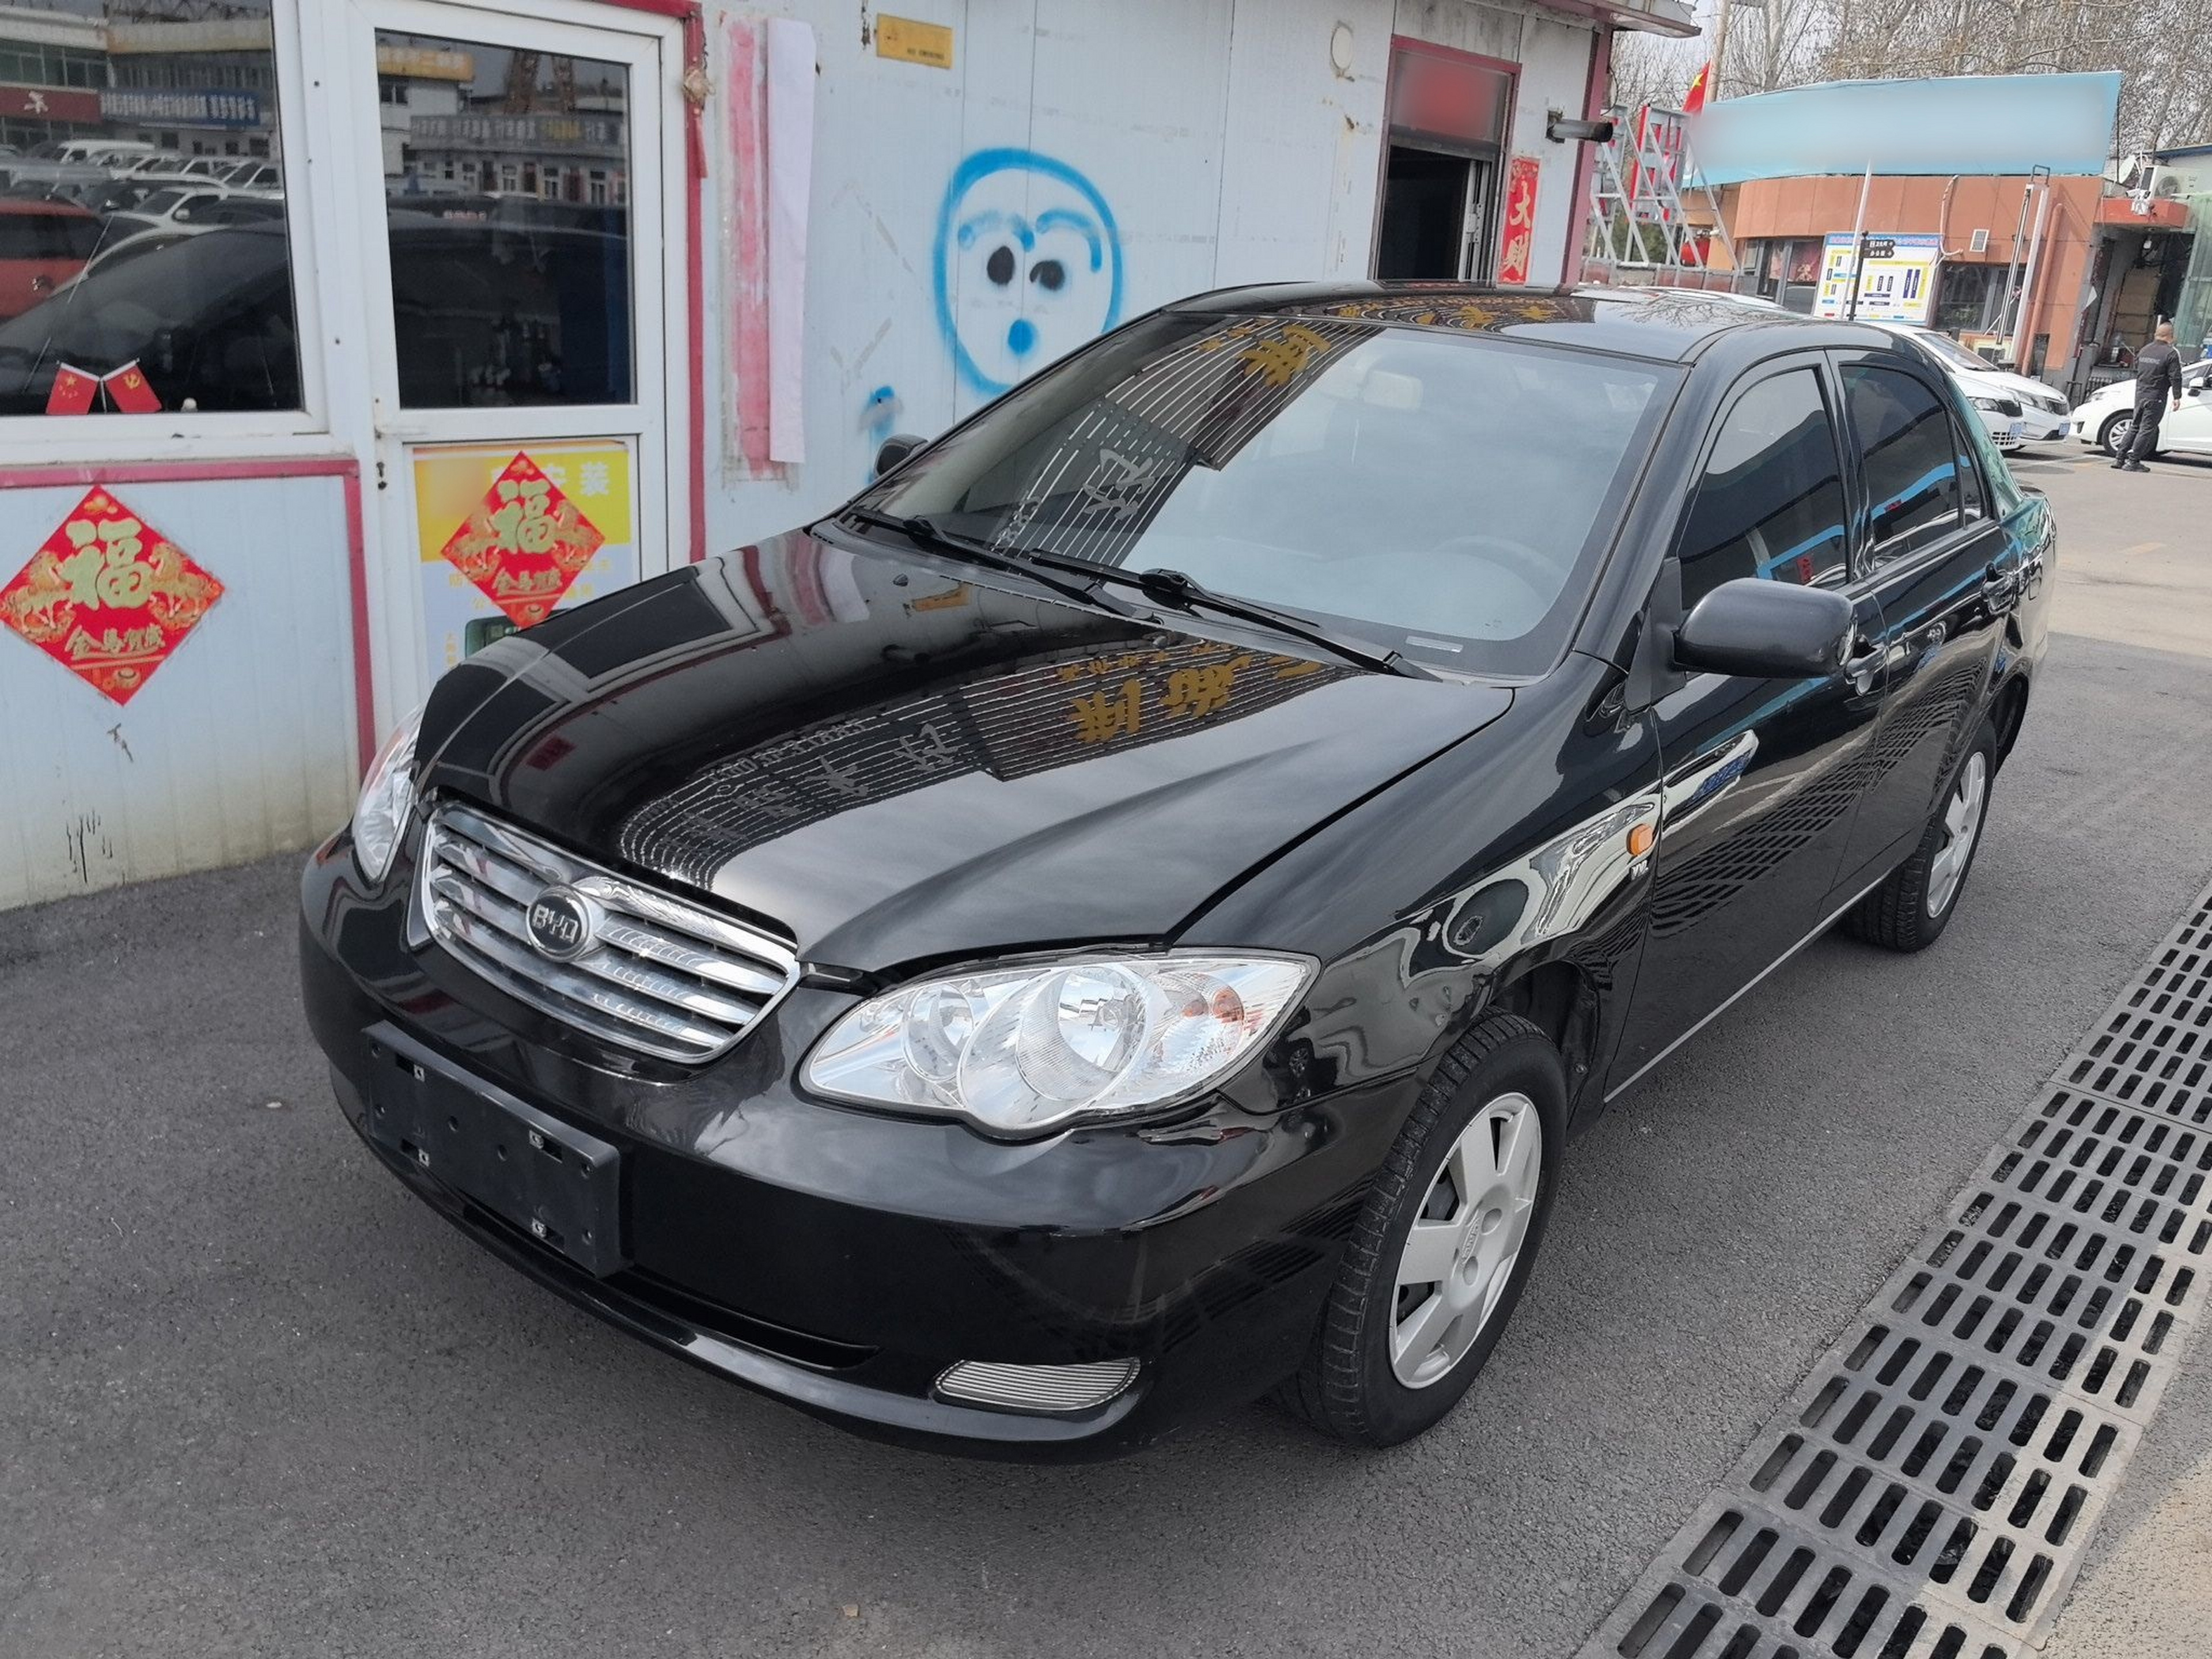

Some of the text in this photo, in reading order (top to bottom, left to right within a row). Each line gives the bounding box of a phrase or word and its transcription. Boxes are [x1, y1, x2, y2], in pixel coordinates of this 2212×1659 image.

[495, 479, 557, 554] 福
[59, 517, 156, 611] 福
[531, 903, 579, 944] BYD
